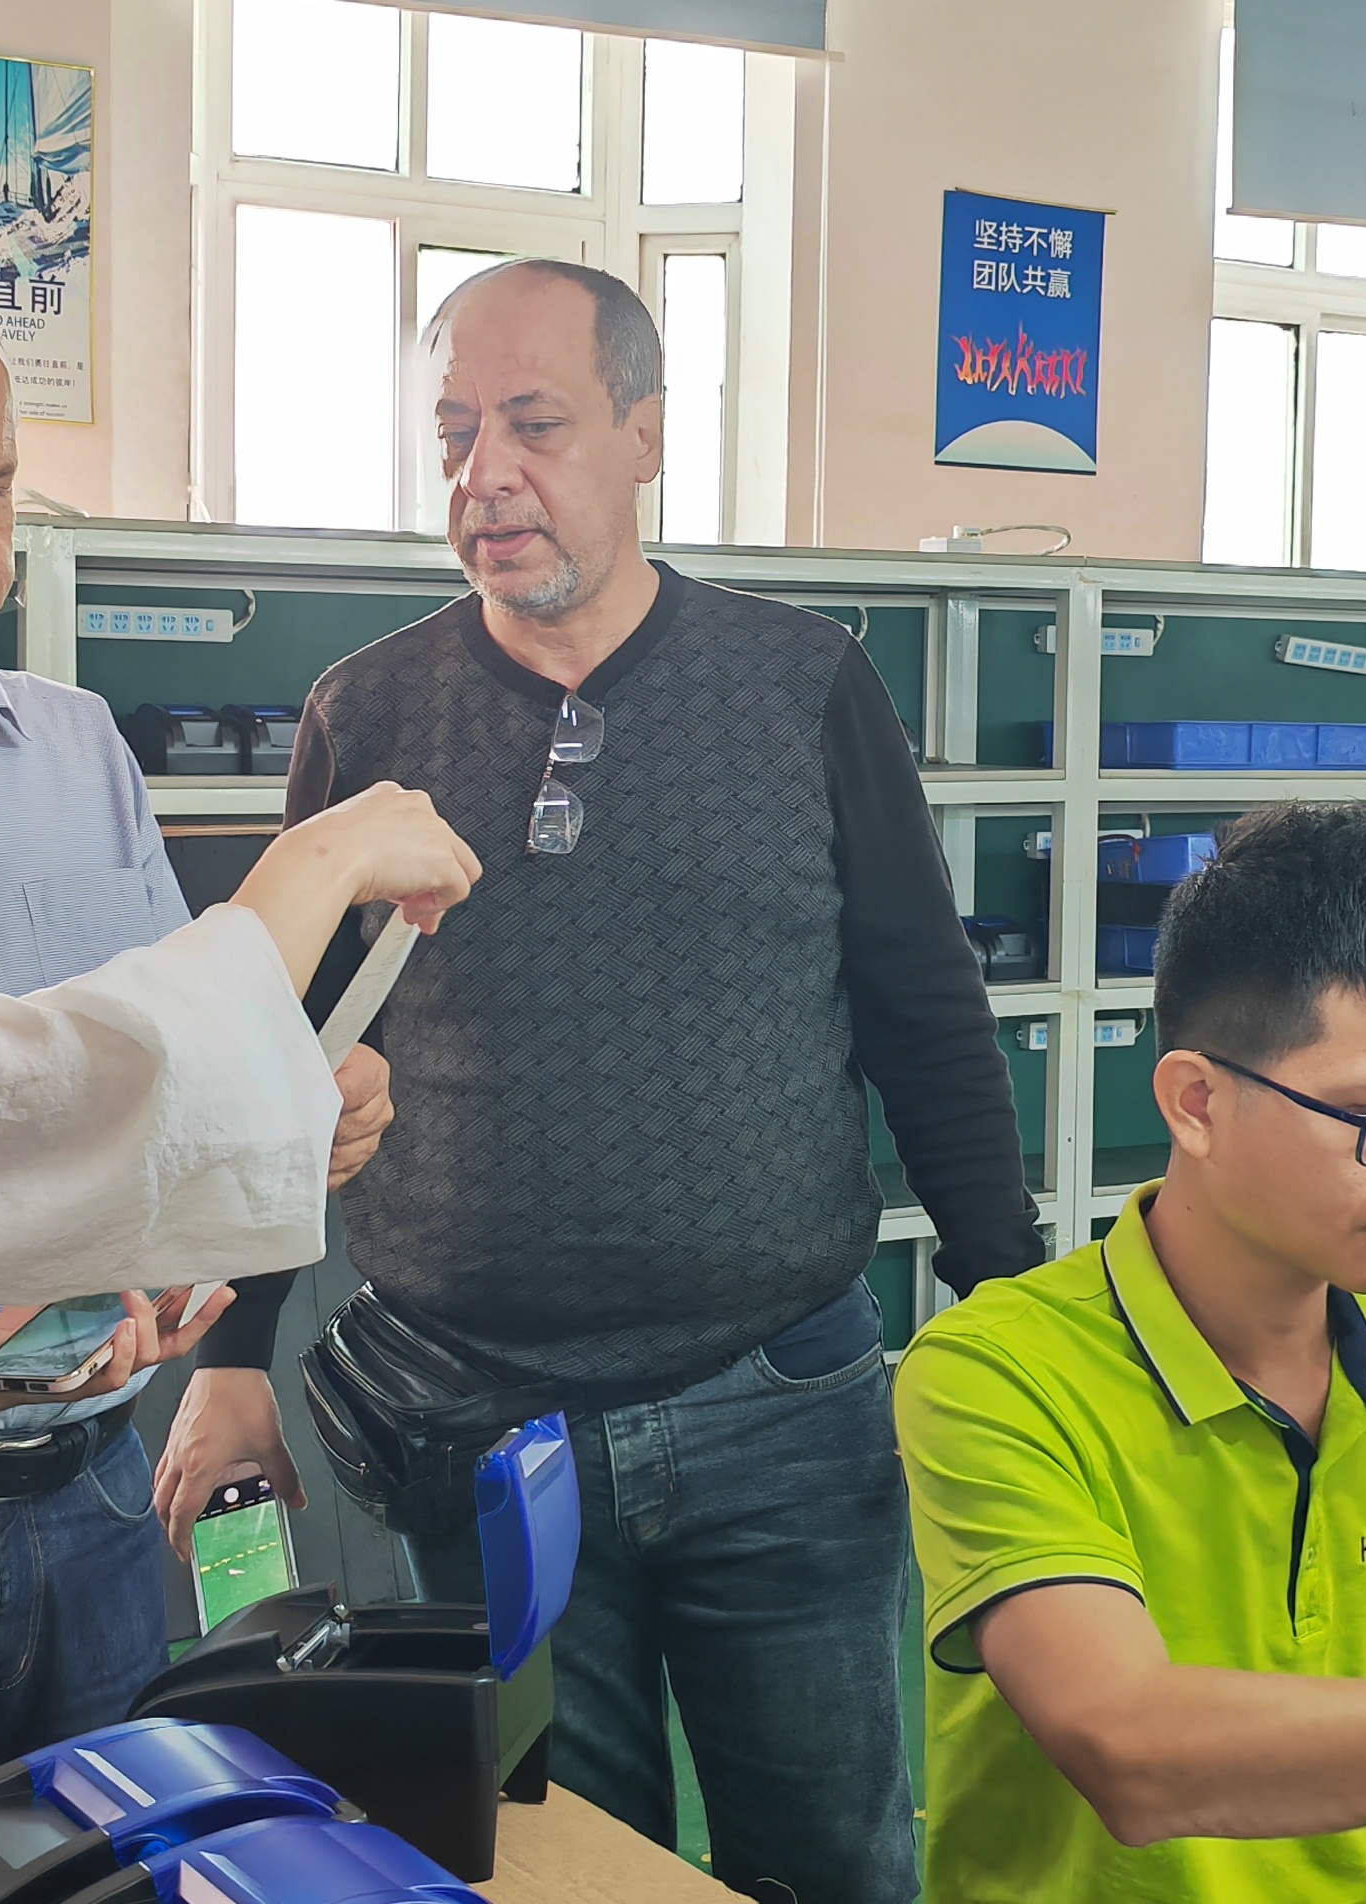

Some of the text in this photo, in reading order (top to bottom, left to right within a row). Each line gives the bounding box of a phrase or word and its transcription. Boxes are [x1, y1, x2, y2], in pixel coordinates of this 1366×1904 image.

[973, 219, 1073, 259] 坚持不懈
[973, 260, 1071, 298] 团队共赢
[6, 315, 46, 330] AHEAD
